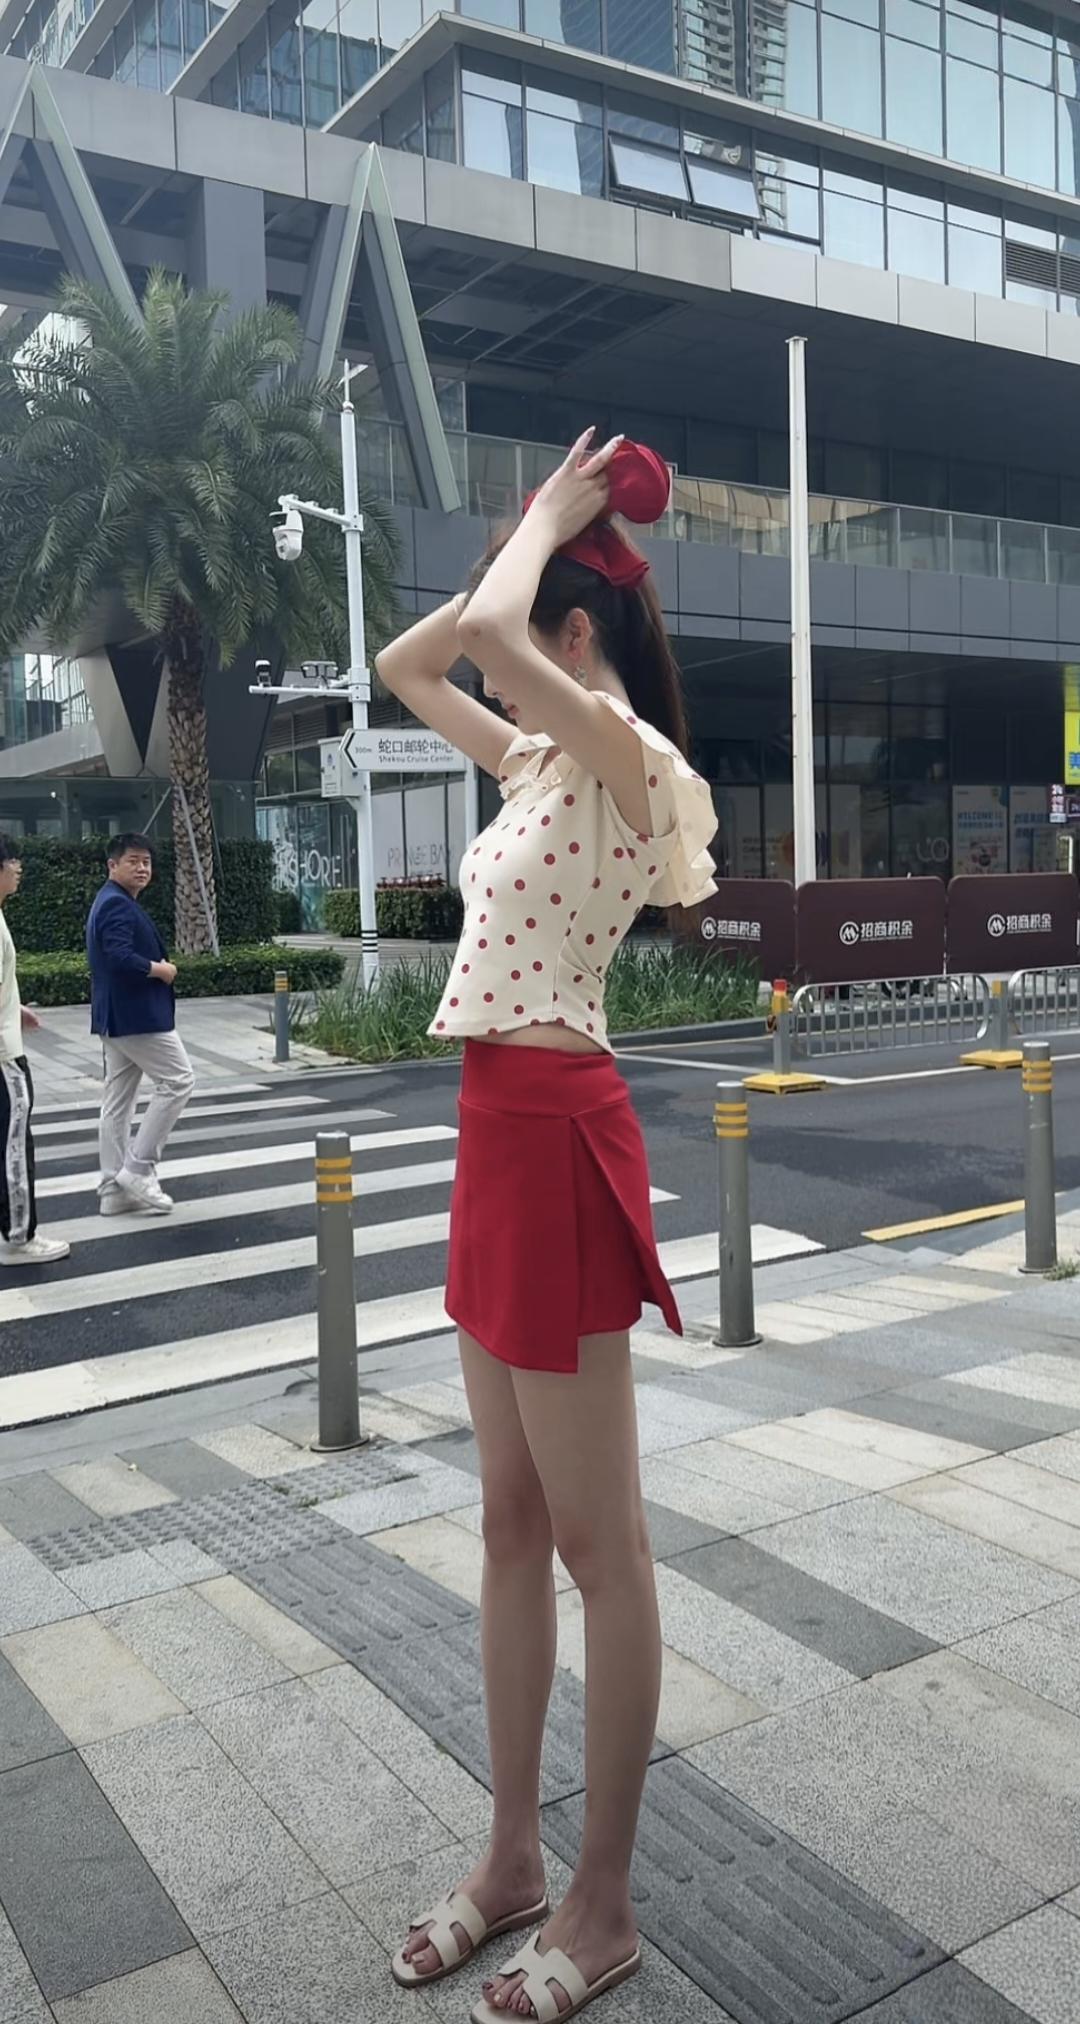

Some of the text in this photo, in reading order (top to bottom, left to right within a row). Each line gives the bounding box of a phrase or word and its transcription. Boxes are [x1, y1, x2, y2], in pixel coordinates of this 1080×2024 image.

[378, 738, 453, 753] 蛇口邮轮中心
[378, 755, 454, 764] Shekou Cruise Center
[861, 920, 913, 938] 招商积余
[1006, 913, 1052, 930] 招商积余
